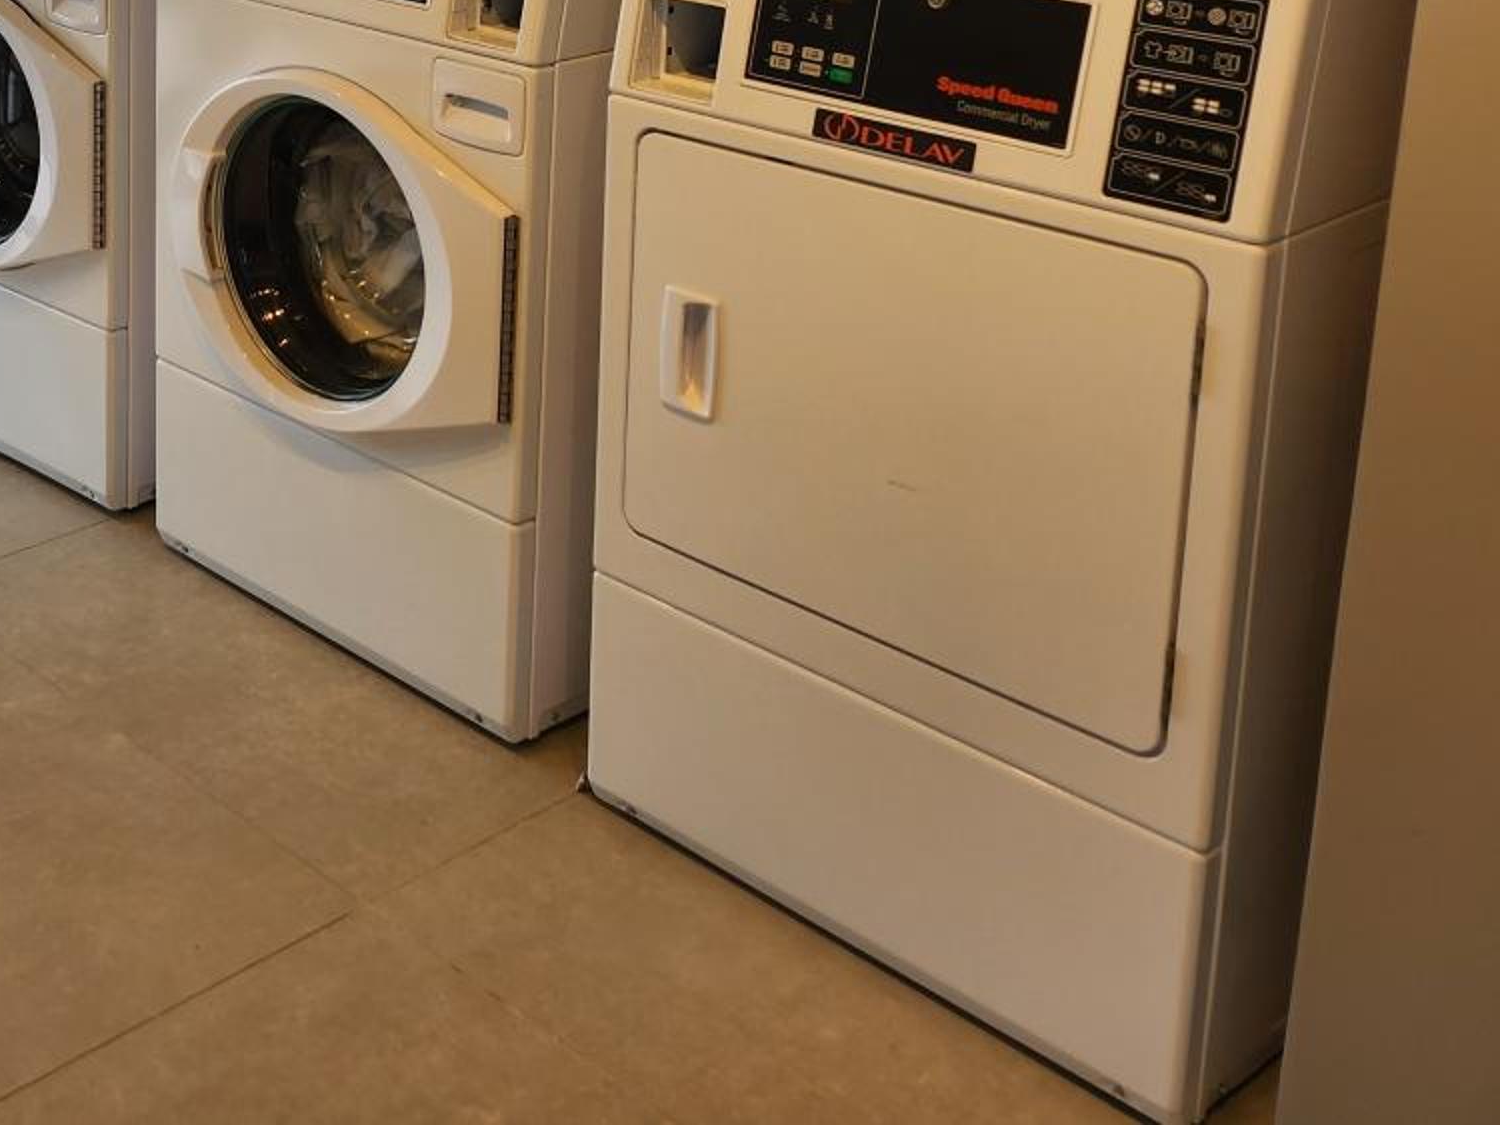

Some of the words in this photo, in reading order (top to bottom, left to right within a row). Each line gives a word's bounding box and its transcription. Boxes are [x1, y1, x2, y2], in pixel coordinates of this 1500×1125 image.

[937, 77, 995, 101] Speed
[997, 88, 1059, 113] Queen
[957, 100, 1018, 124] Commercial
[1021, 114, 1052, 130] Dryer
